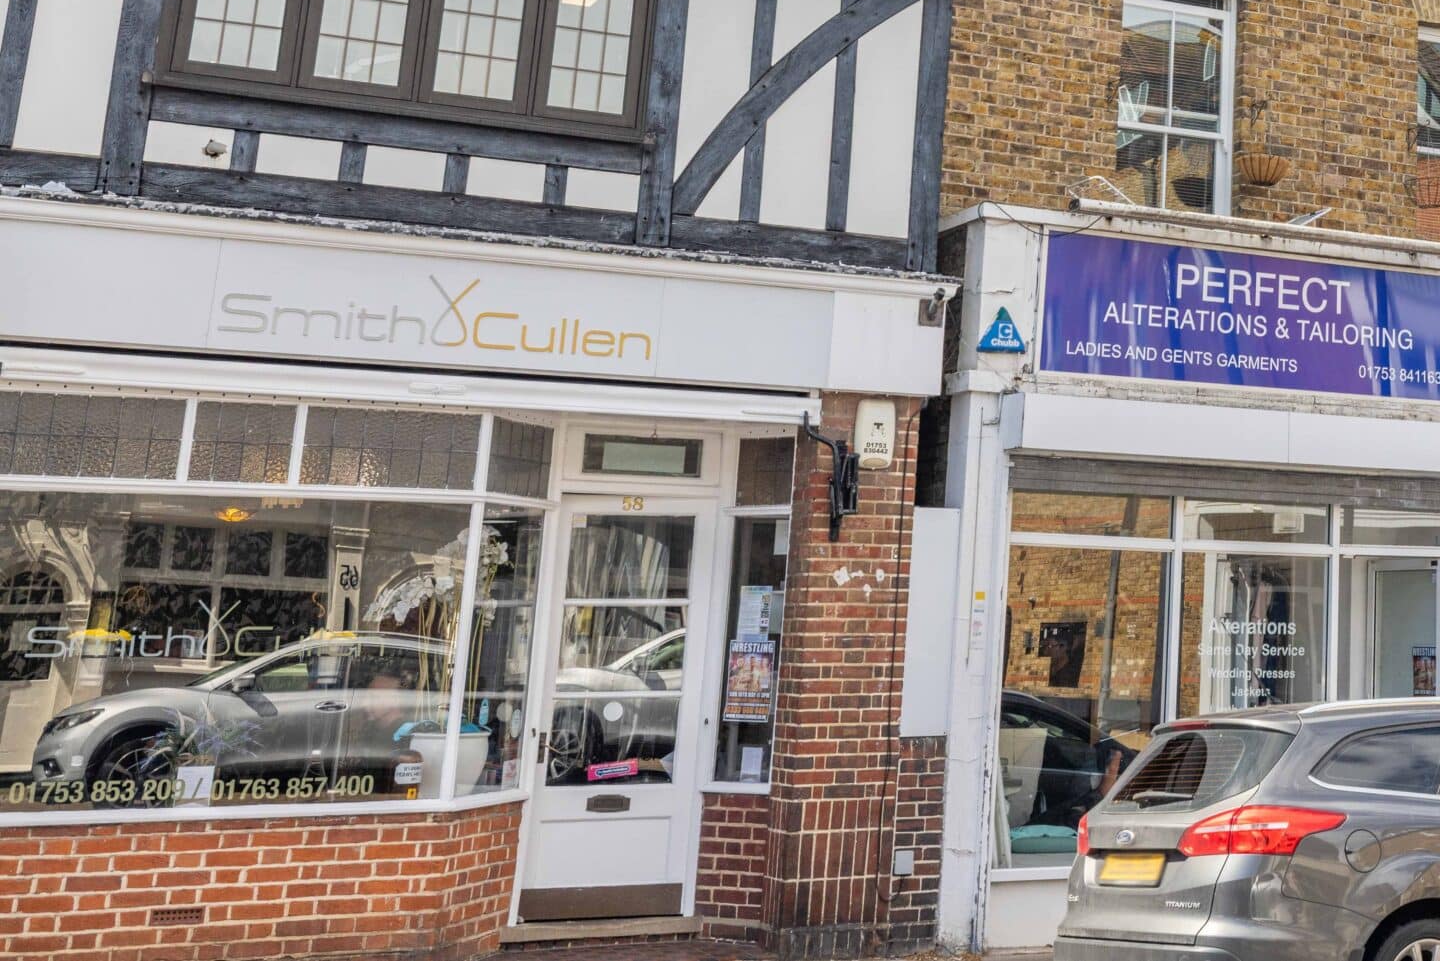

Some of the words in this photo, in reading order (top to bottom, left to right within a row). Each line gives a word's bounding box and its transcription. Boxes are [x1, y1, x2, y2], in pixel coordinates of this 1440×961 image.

[1176, 263, 1351, 315] PERFECT
[218, 292, 426, 345] Smith
[473, 311, 652, 361] Cullen
[1103, 301, 1267, 337] ALTERATIONS
[1275, 317, 1290, 340] &
[1297, 319, 1413, 350] TAILORING
[991, 338, 1020, 347] Chubb
[1066, 340, 1122, 359] LADIES
[1124, 345, 1157, 361] AND
[1161, 349, 1213, 366] GENTS
[1217, 353, 1298, 373] GARMENTS
[1358, 365, 1395, 381] 01753
[622, 496, 644, 511] 58
[1208, 618, 1296, 635] Alterations
[731, 641, 774, 654] WRESTLING
[1198, 644, 1232, 656] Same
[1235, 644, 1258, 659] Day
[1262, 643, 1305, 656] Service
[1207, 668, 1252, 681] Wedding
[1254, 668, 1296, 679] Dresses
[8, 781, 85, 804] 01753
[90, 779, 136, 803] 853
[141, 778, 186, 801] 209
[211, 778, 281, 801] 01763
[285, 777, 328, 799] 857
[334, 775, 374, 796] 400
[1165, 900, 1201, 910] TITANIUM
